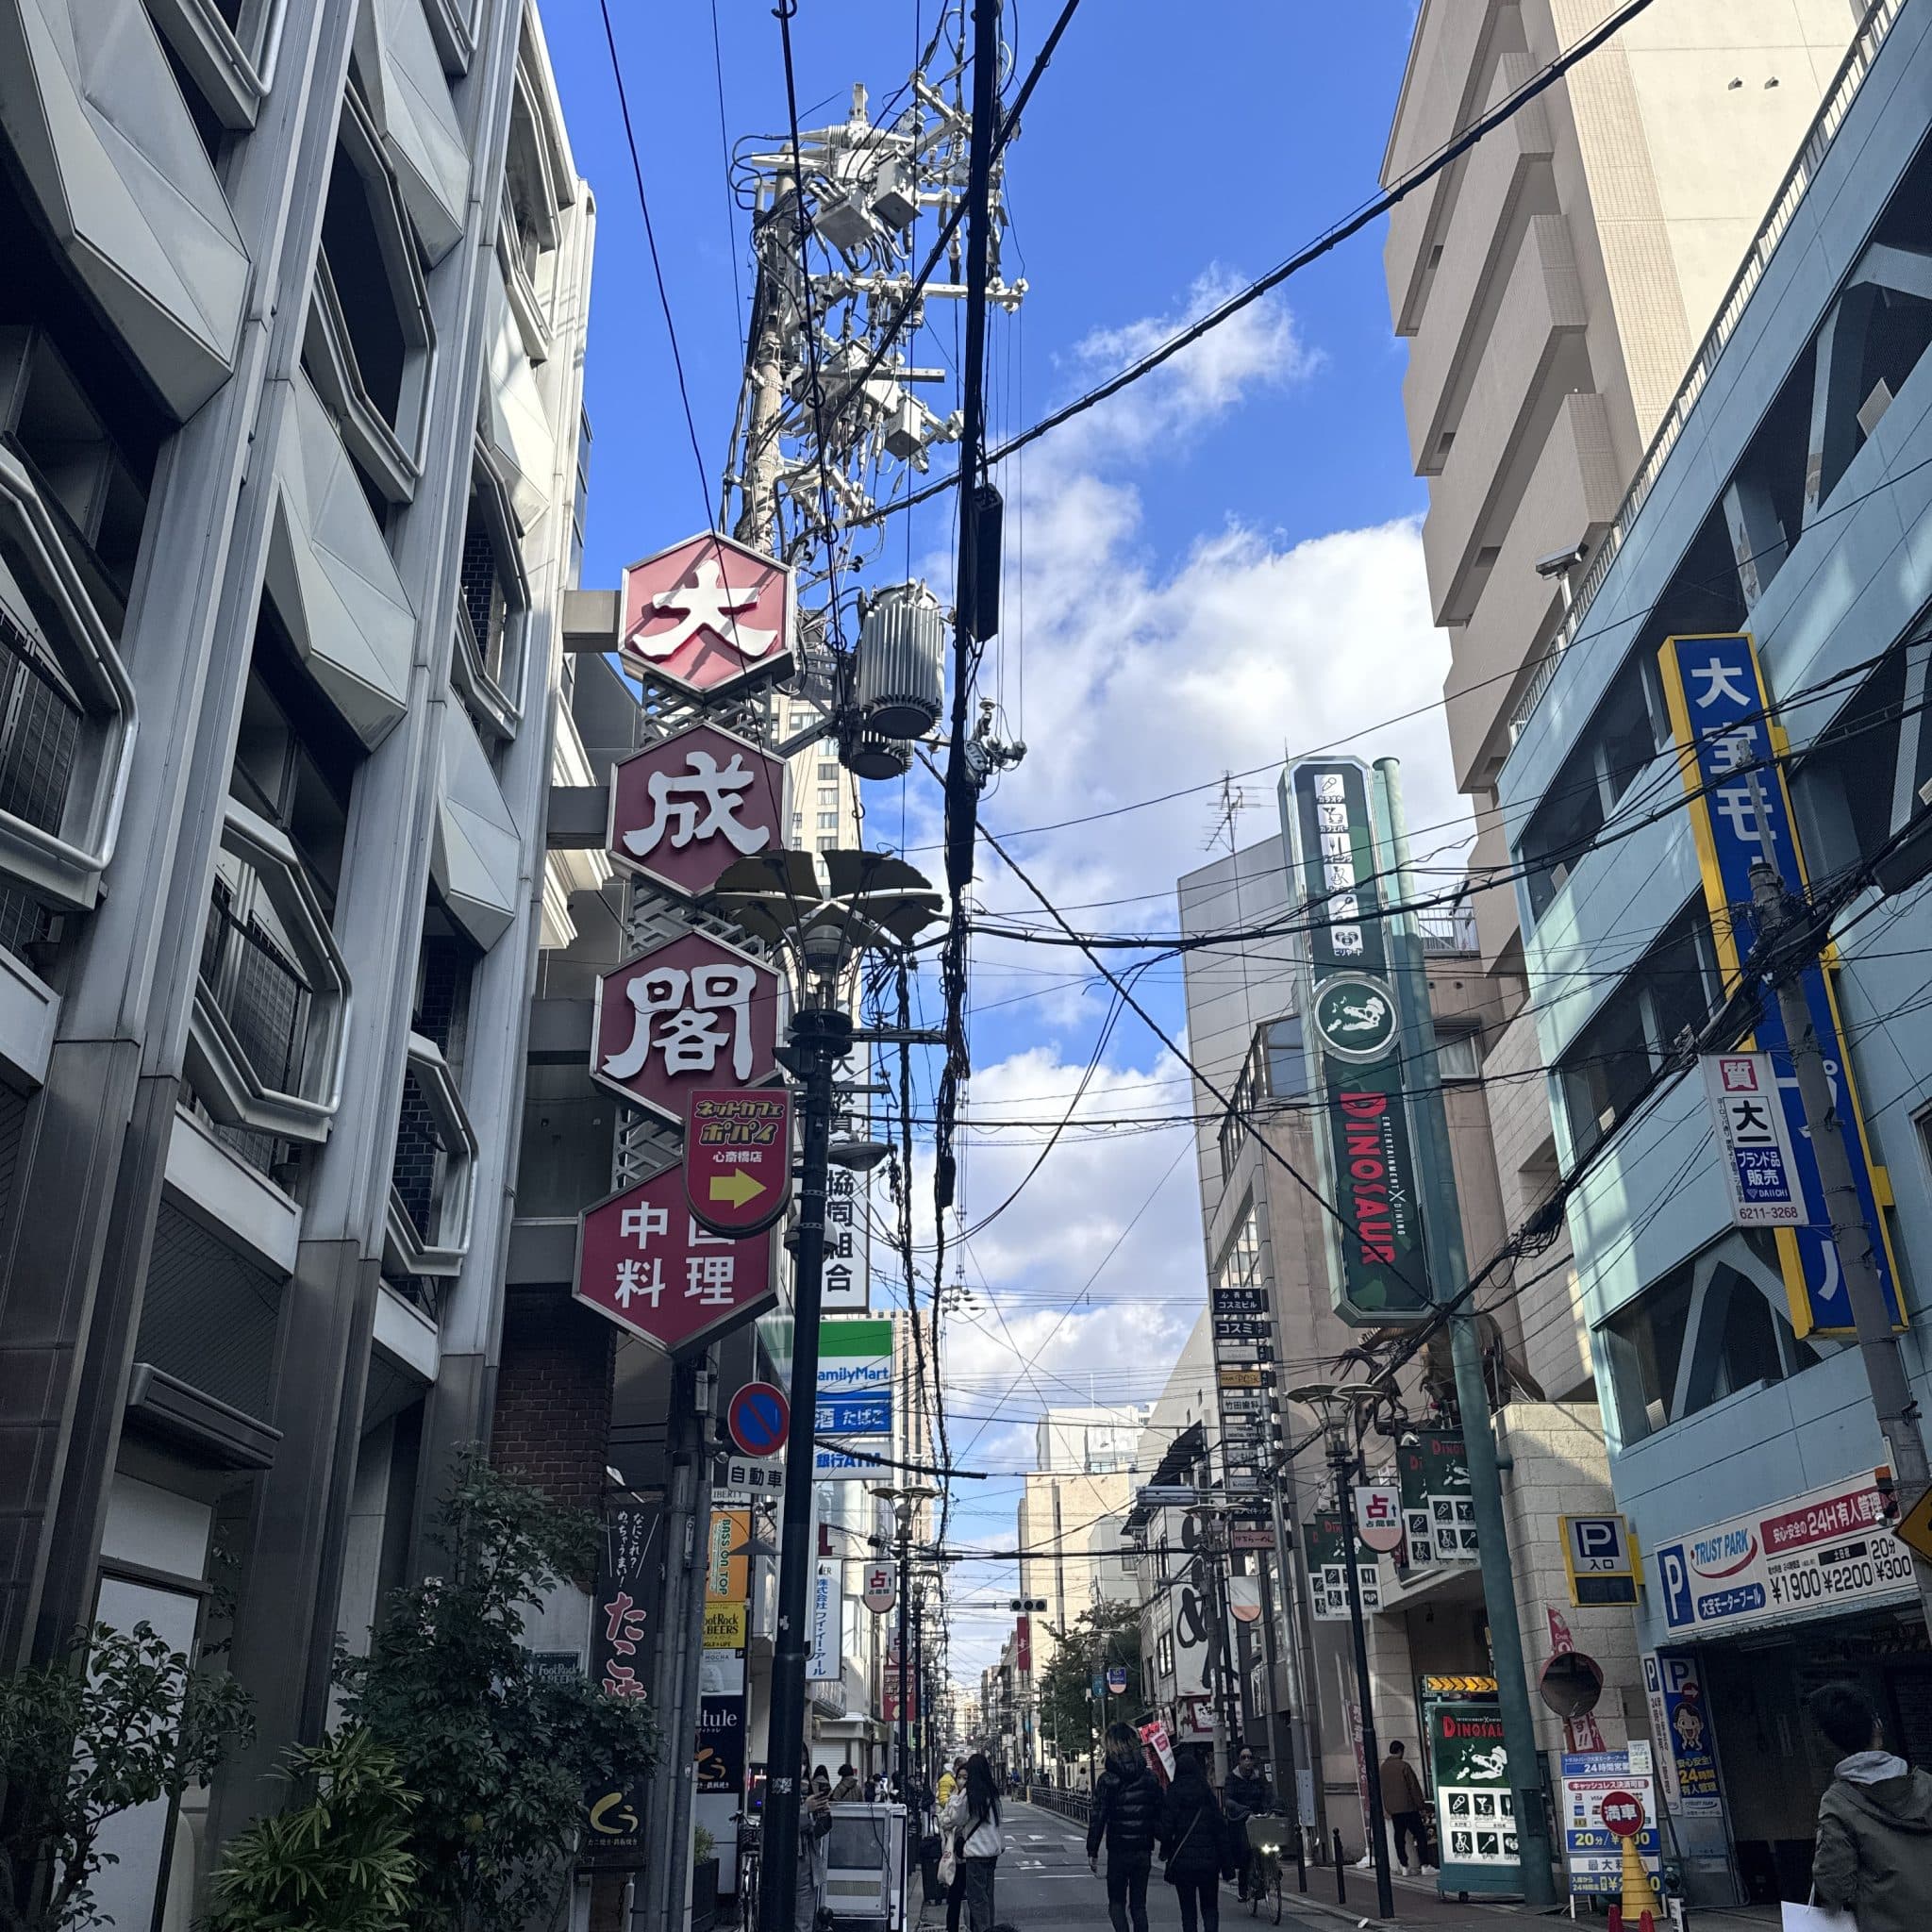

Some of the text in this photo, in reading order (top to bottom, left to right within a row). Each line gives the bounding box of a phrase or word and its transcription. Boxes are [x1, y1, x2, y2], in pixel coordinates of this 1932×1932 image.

[602, 559, 778, 1080] 大 成 閣
[1334, 948, 1361, 957] ビリヤード
[695, 1100, 784, 1119] ネットカフェ
[700, 1120, 778, 1145] ポパイ
[712, 1151, 763, 1163] 心斎橋店
[1737, 1151, 1781, 1168] ブランド品
[1340, 1091, 1396, 1265] DINOSAUR
[1747, 1169, 1779, 1186] 販売
[1740, 1208, 1798, 1219] 6211-3268
[614, 1256, 735, 1309] 料理
[1219, 1324, 1253, 1334] コスミ
[818, 1367, 889, 1383] amilyMart
[842, 1408, 885, 1425] たばこ
[730, 1466, 783, 1488] 自動車
[1366, 1494, 1389, 1518] 占
[1694, 1528, 1749, 1566] TRUST PARK
[1871, 1538, 1896, 1559] 20分
[1590, 1558, 1614, 1571] 入口
[1874, 1556, 1912, 1582] ¥300
[719, 1571, 728, 1596] TOP
[870, 1570, 887, 1588] 占
[1664, 1555, 1683, 1620] P
[1770, 1568, 1822, 1605] ¥1900
[1822, 1562, 1874, 1594] ¥2200
[1701, 1586, 1762, 1617] 大宝モータープール
[704, 1613, 740, 1625] ootRock
[1670, 1661, 1689, 1691] P
[702, 1709, 738, 1727] tule
[1679, 1769, 1716, 1785] 24時間
[1605, 1804, 1638, 1822] 満車
